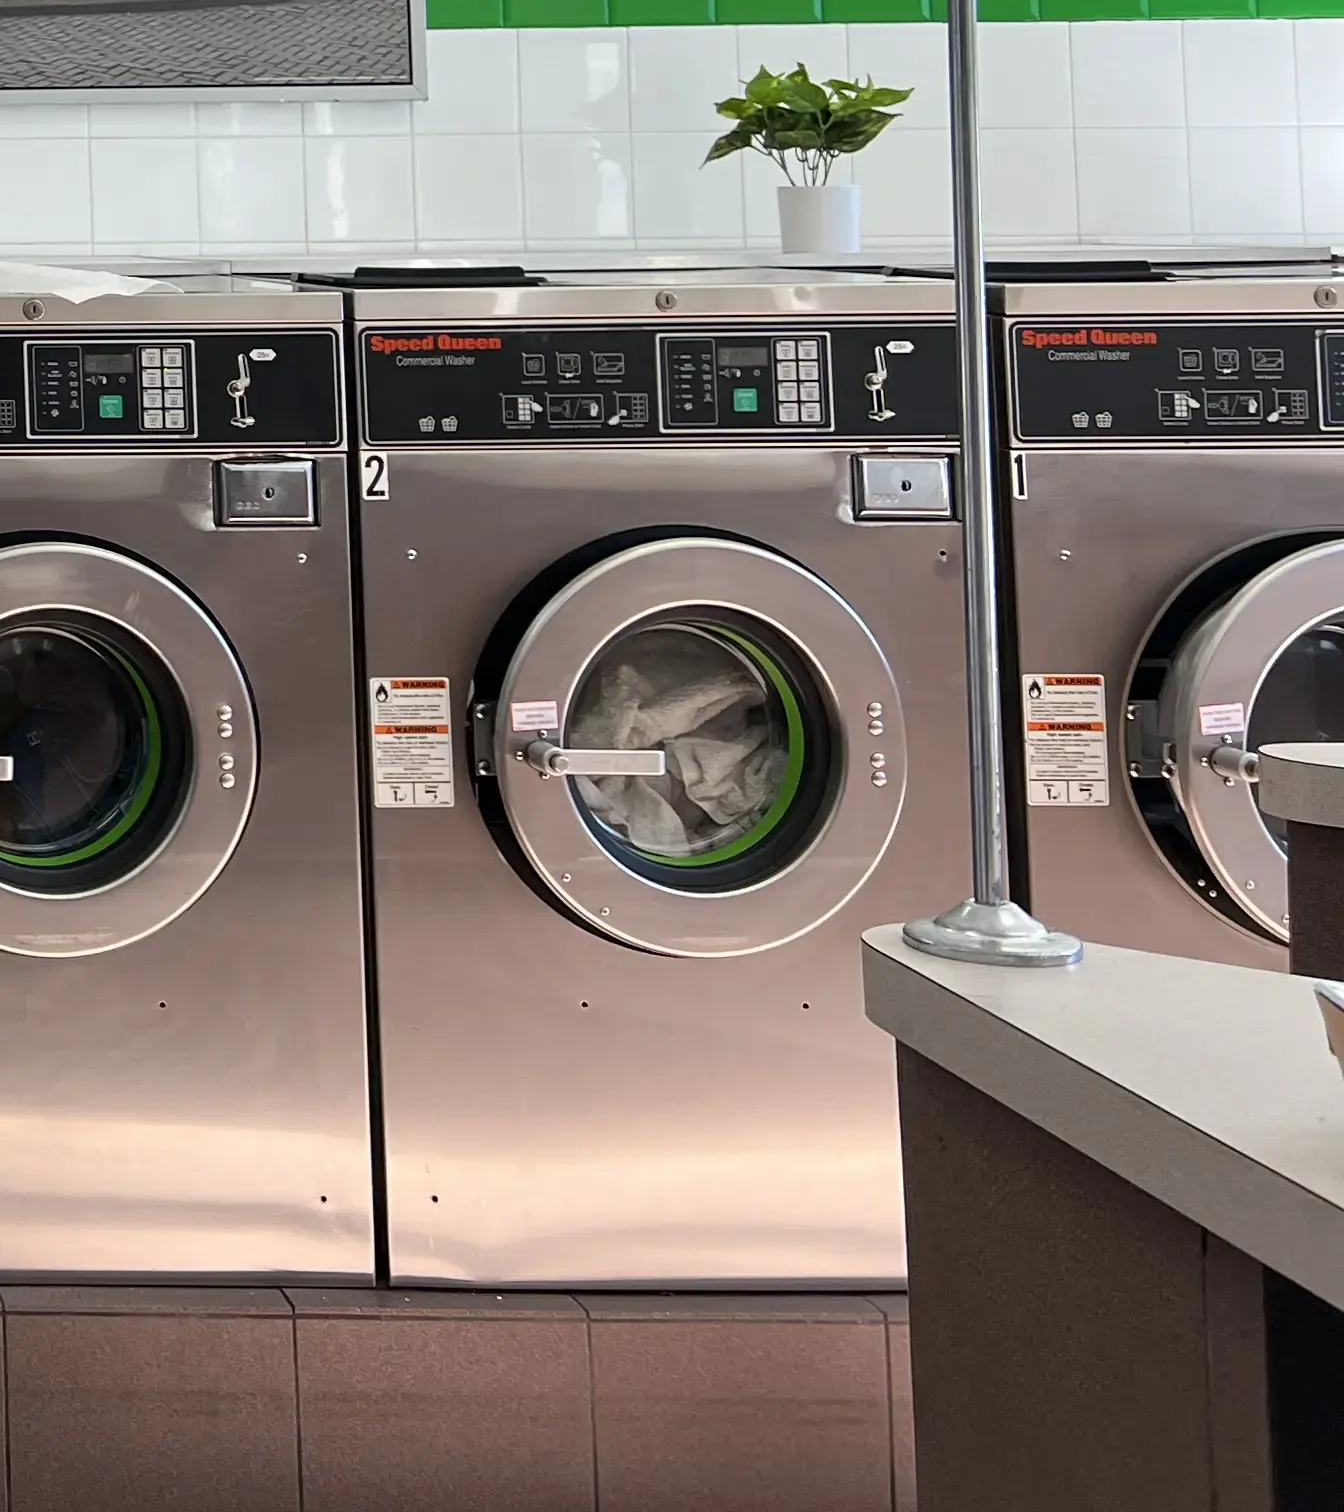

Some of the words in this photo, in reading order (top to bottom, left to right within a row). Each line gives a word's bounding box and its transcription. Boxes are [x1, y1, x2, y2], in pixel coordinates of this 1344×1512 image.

[370, 335, 434, 355] Speed
[437, 334, 502, 350] Queen
[1022, 329, 1088, 349] Speed
[1090, 328, 1158, 345] Queen
[396, 355, 443, 366] Commercial
[444, 355, 476, 366] Washer
[1048, 349, 1096, 361] Commercial
[1097, 349, 1131, 361] Washer
[365, 455, 385, 497] 2
[1014, 454, 1025, 496] 1
